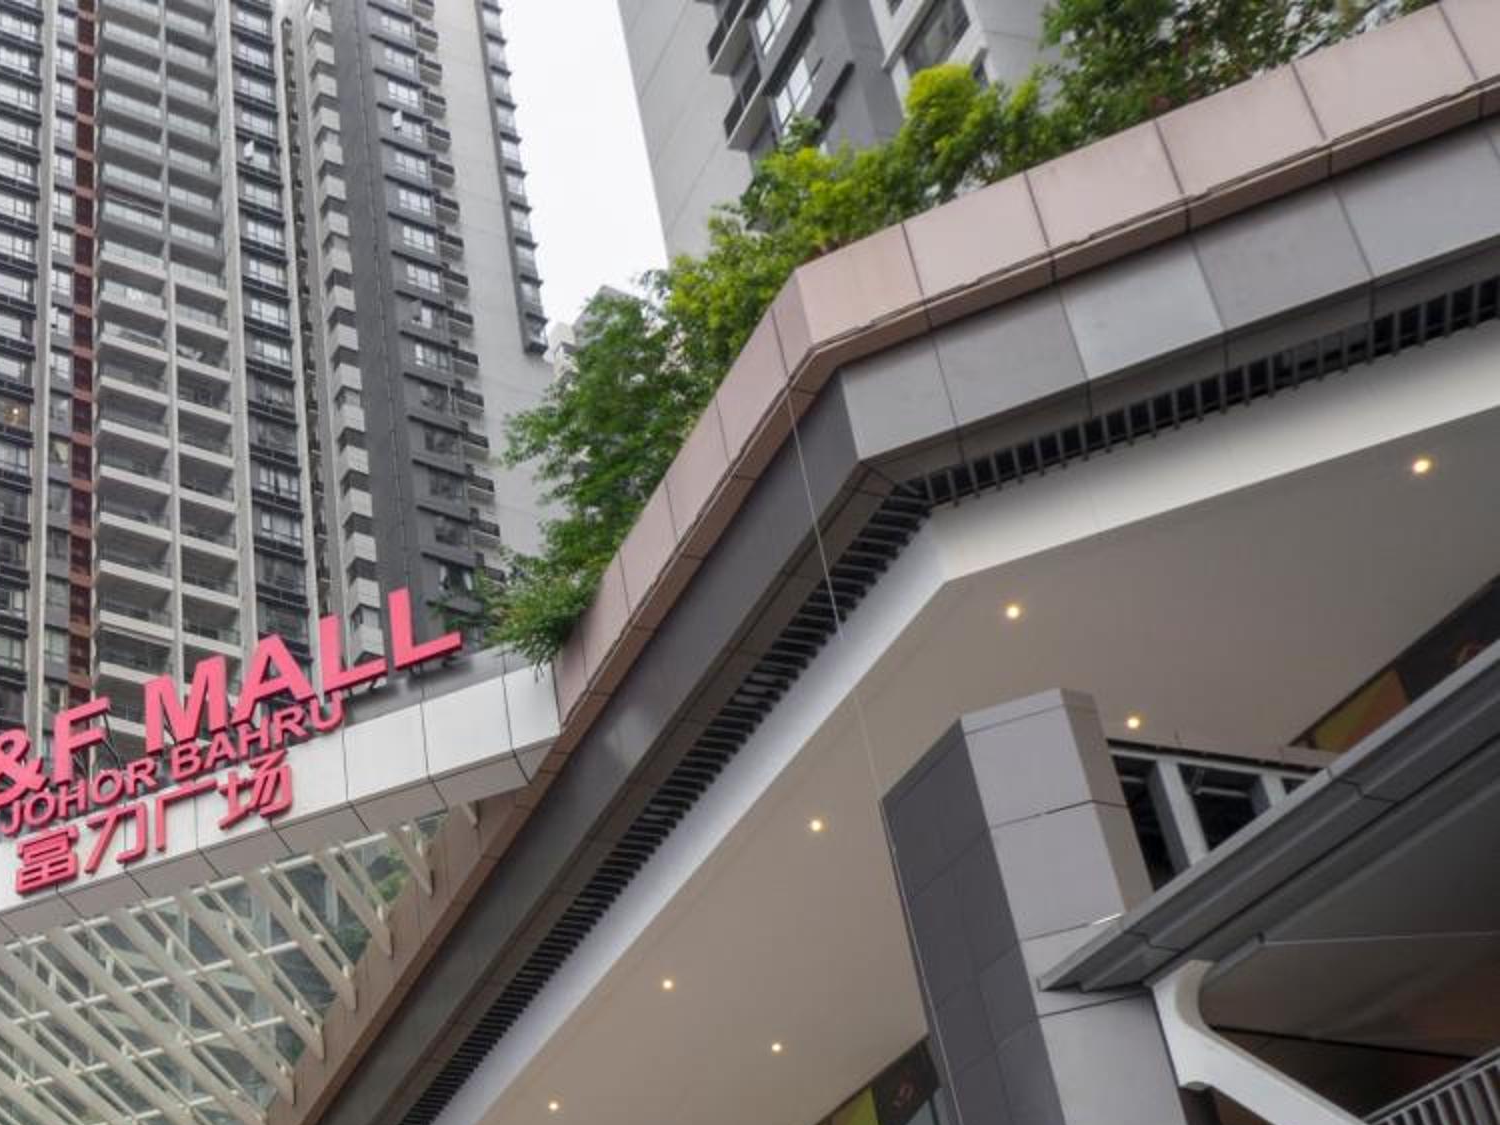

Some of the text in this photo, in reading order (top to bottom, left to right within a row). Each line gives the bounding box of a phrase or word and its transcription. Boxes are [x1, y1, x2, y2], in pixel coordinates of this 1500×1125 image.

[146, 587, 462, 758] MALL
[3, 693, 344, 837] JOHOR BAHRU
[15, 748, 294, 895] 富力广场
